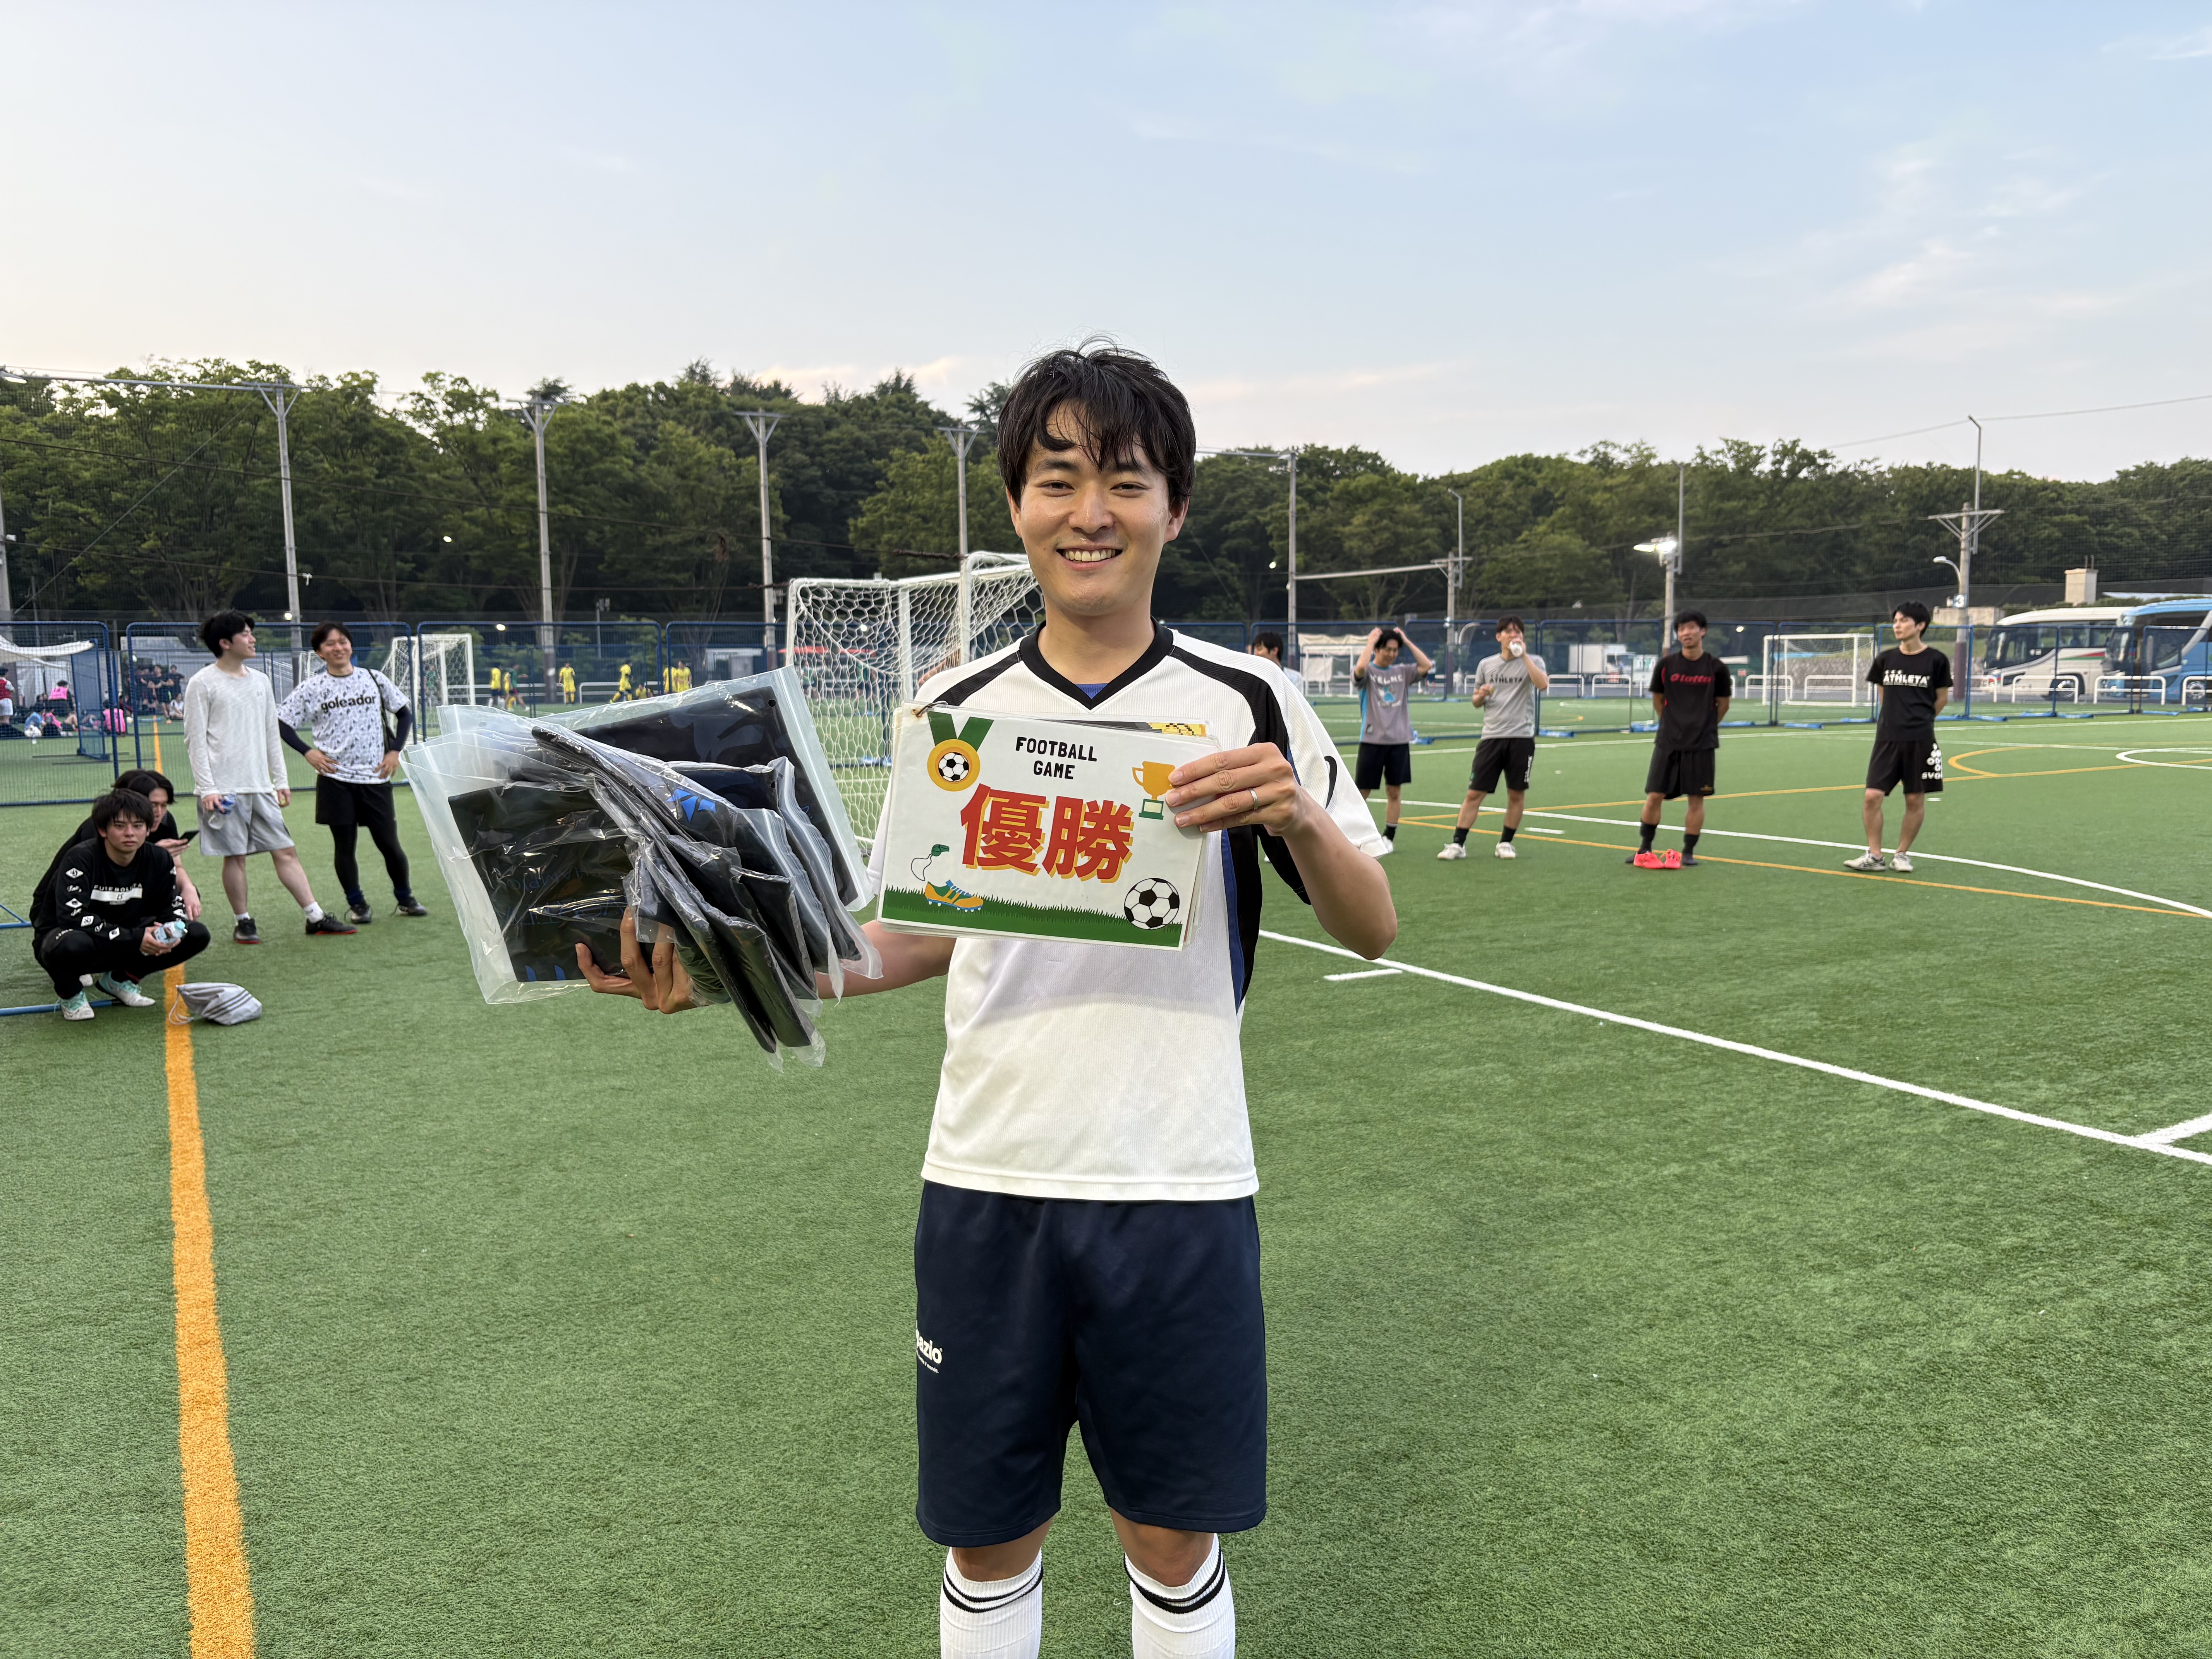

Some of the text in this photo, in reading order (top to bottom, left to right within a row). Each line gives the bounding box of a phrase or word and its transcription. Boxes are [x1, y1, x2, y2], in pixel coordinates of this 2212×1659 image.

[1955, 594, 1964, 608] 3
[1883, 673, 1928, 685] ATHLETA
[321, 695, 376, 714] goleador
[1015, 736, 1097, 762] FOOTBALL
[1033, 760, 1075, 780] GAME
[960, 783, 1133, 883] 優勝
[916, 1329, 942, 1364] pazio
